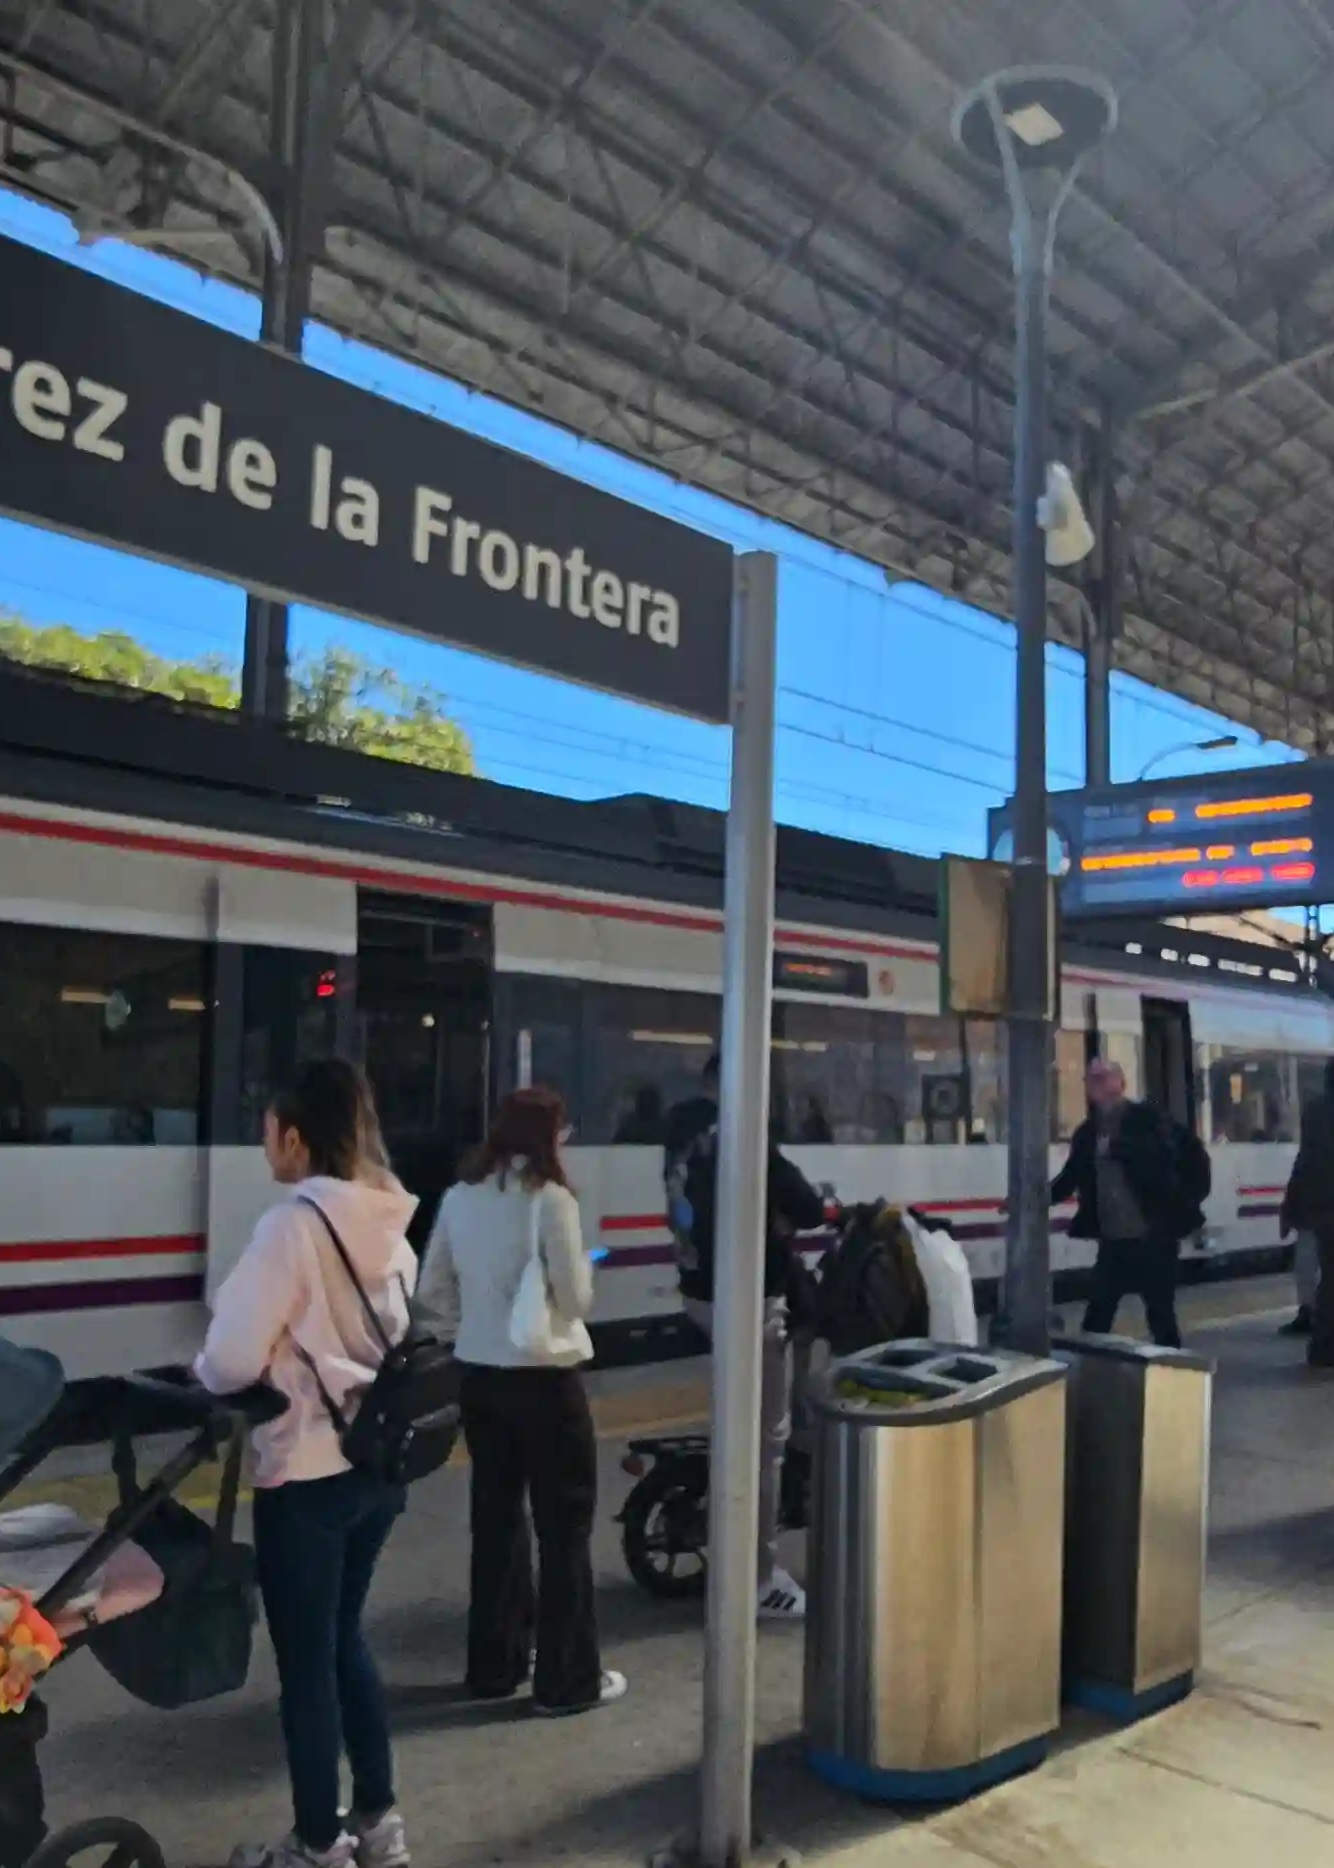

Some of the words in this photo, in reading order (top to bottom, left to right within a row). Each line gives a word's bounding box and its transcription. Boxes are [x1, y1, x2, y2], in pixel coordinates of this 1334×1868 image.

[162, 402, 277, 511] de
[312, 445, 380, 547] la
[413, 486, 680, 649] Frontera
